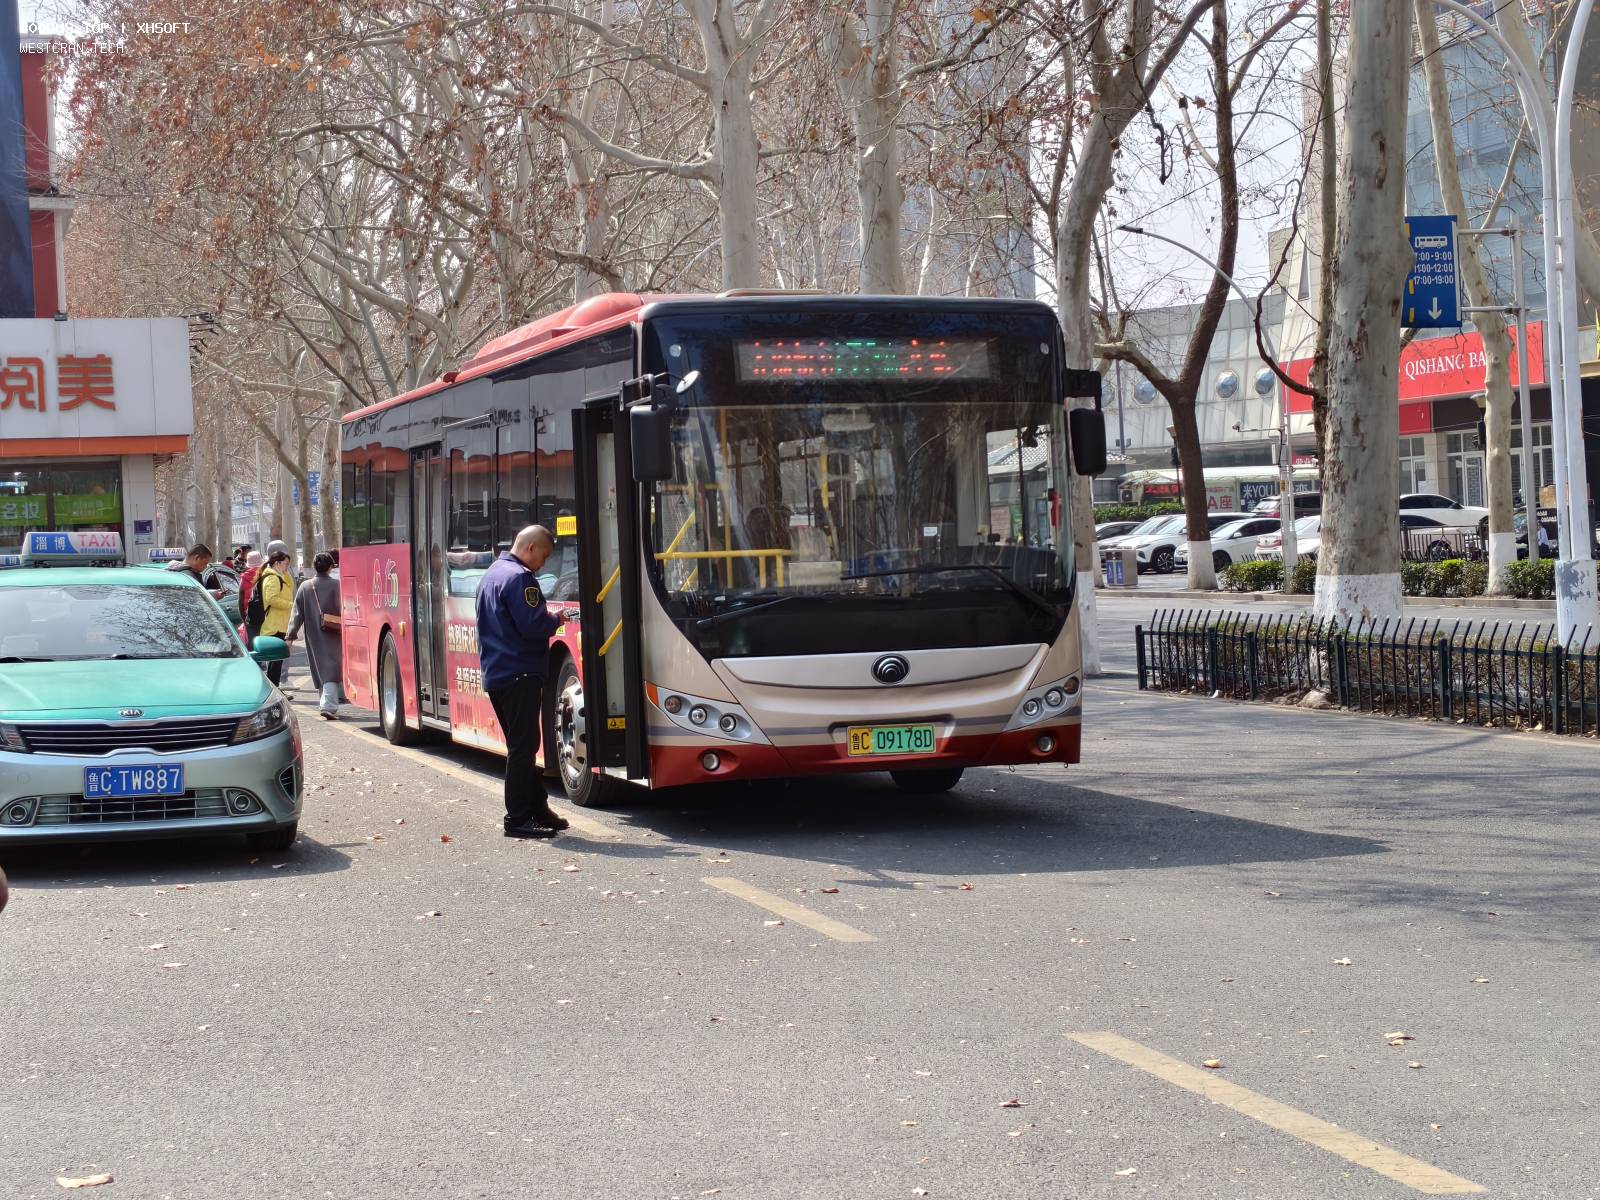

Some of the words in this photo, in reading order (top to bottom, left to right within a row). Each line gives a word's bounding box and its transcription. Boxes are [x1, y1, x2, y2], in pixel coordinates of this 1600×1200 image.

[1405, 353, 1465, 381] QISHANG
[1468, 350, 1487, 369] BA
[79, 534, 116, 547] TAXI
